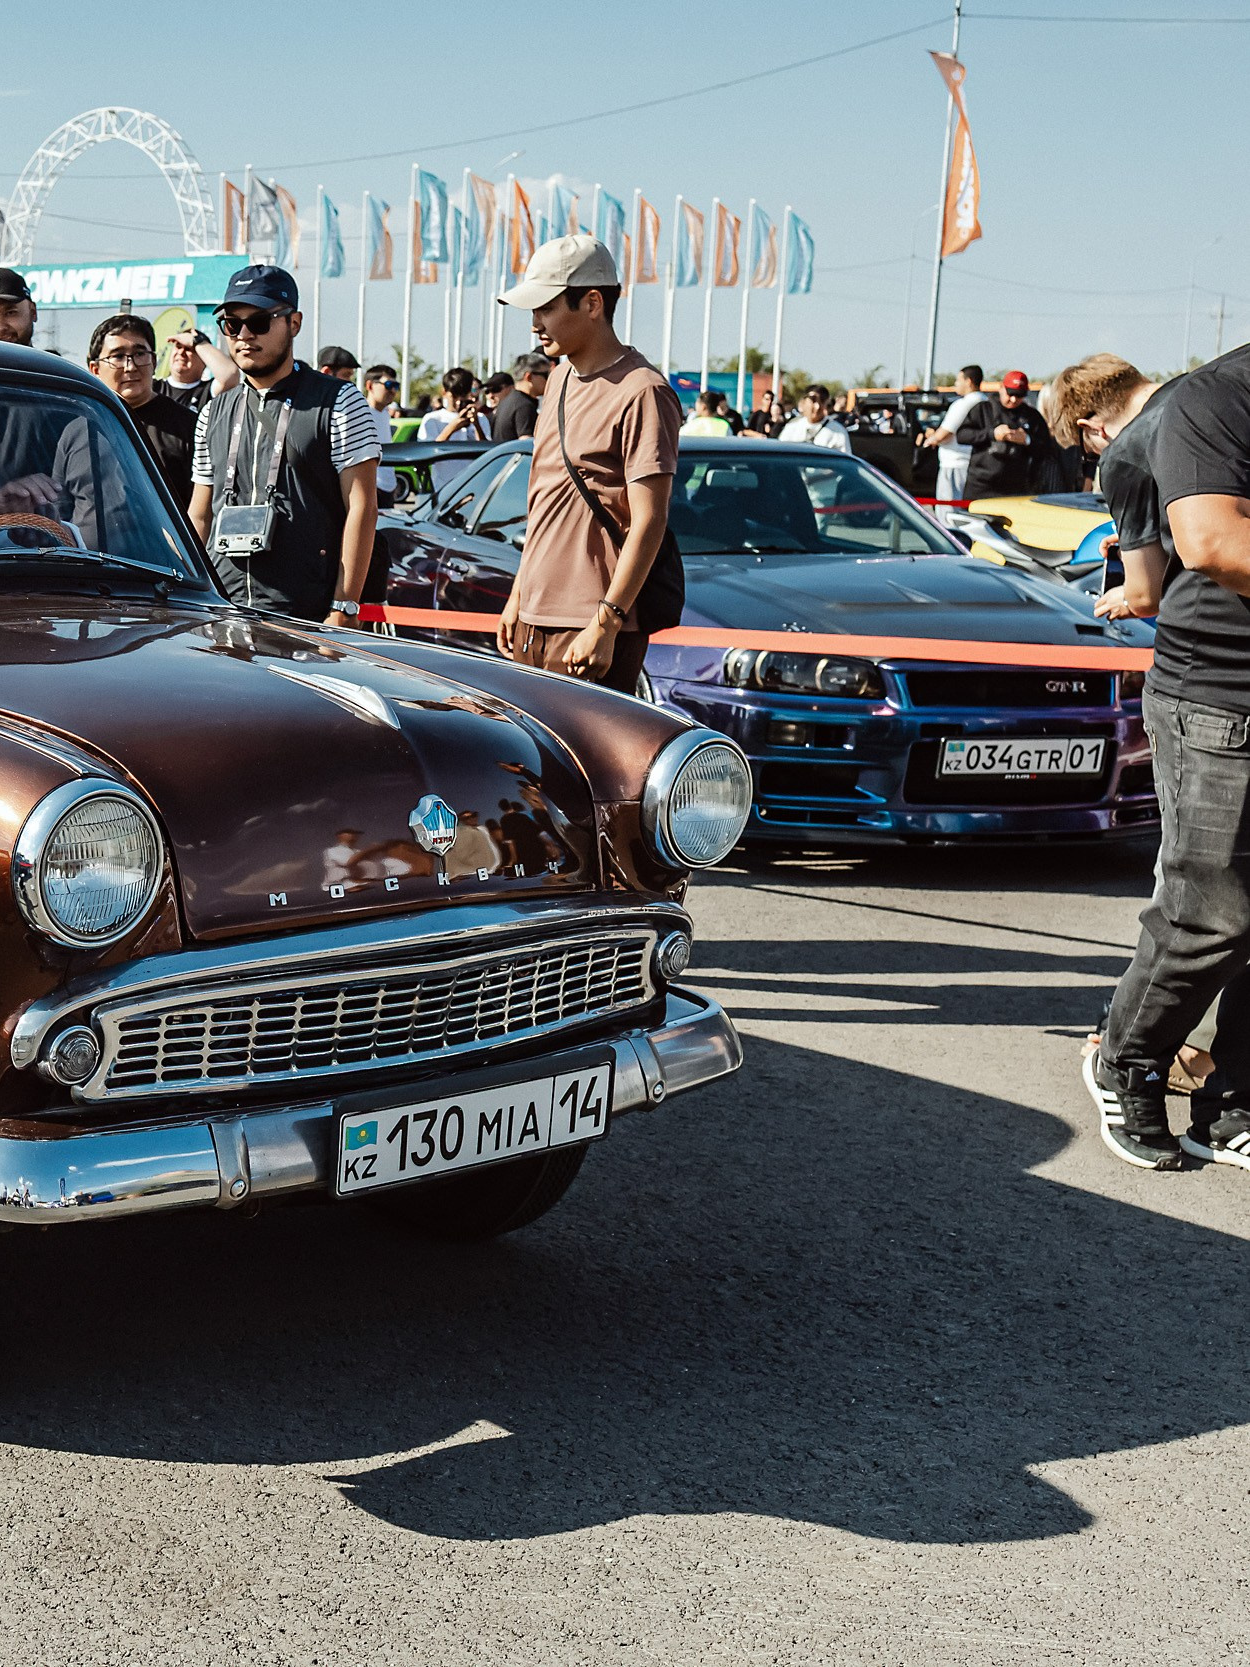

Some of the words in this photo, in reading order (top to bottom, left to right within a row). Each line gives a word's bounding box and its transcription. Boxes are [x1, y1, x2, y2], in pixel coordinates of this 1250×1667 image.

[17, 263, 194, 304] OWKZMEET
[944, 760, 962, 771] KZ
[1069, 744, 1101, 770] 01
[268, 861, 560, 907] МОСКВИЧ
[386, 1105, 465, 1172] 130
[476, 1101, 540, 1155] MIA
[559, 1075, 603, 1134] 14
[344, 1154, 378, 1183] KZ
